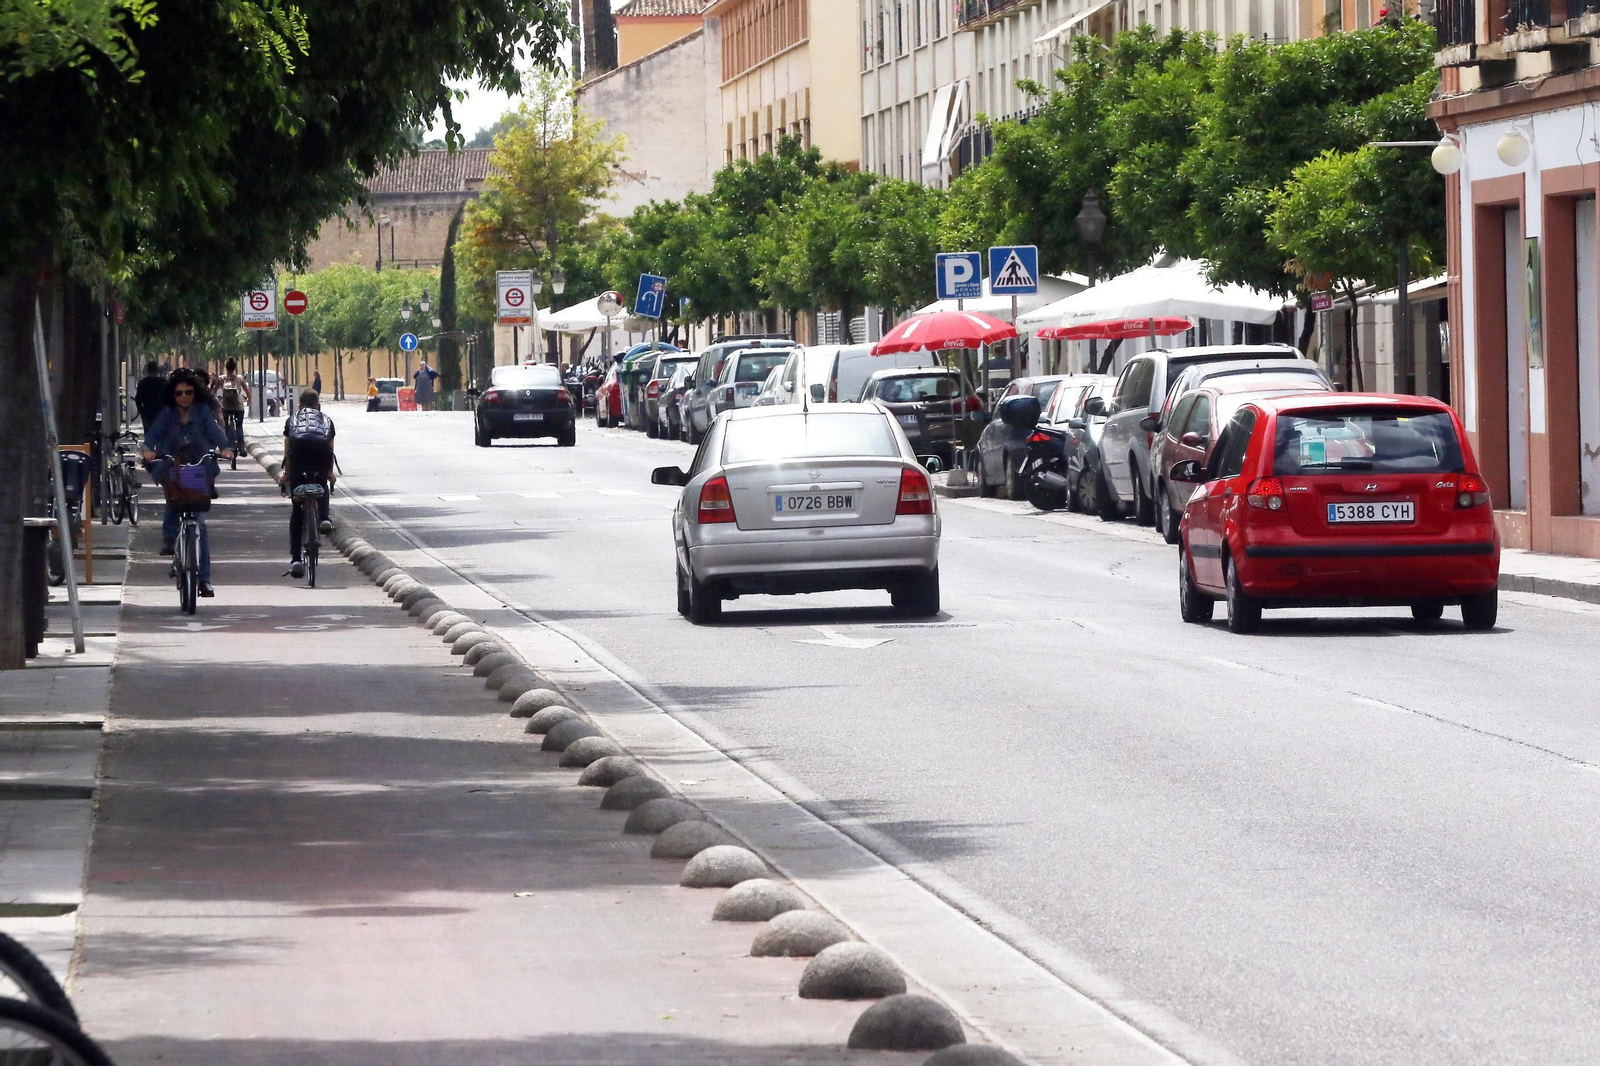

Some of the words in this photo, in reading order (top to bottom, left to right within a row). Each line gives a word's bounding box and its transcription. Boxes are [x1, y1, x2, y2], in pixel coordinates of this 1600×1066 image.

[945, 258, 973, 295] P
[788, 496, 822, 510] 0726
[828, 495, 853, 509] BBW
[1337, 505, 1375, 519] 5388
[1381, 504, 1410, 519] CYH
